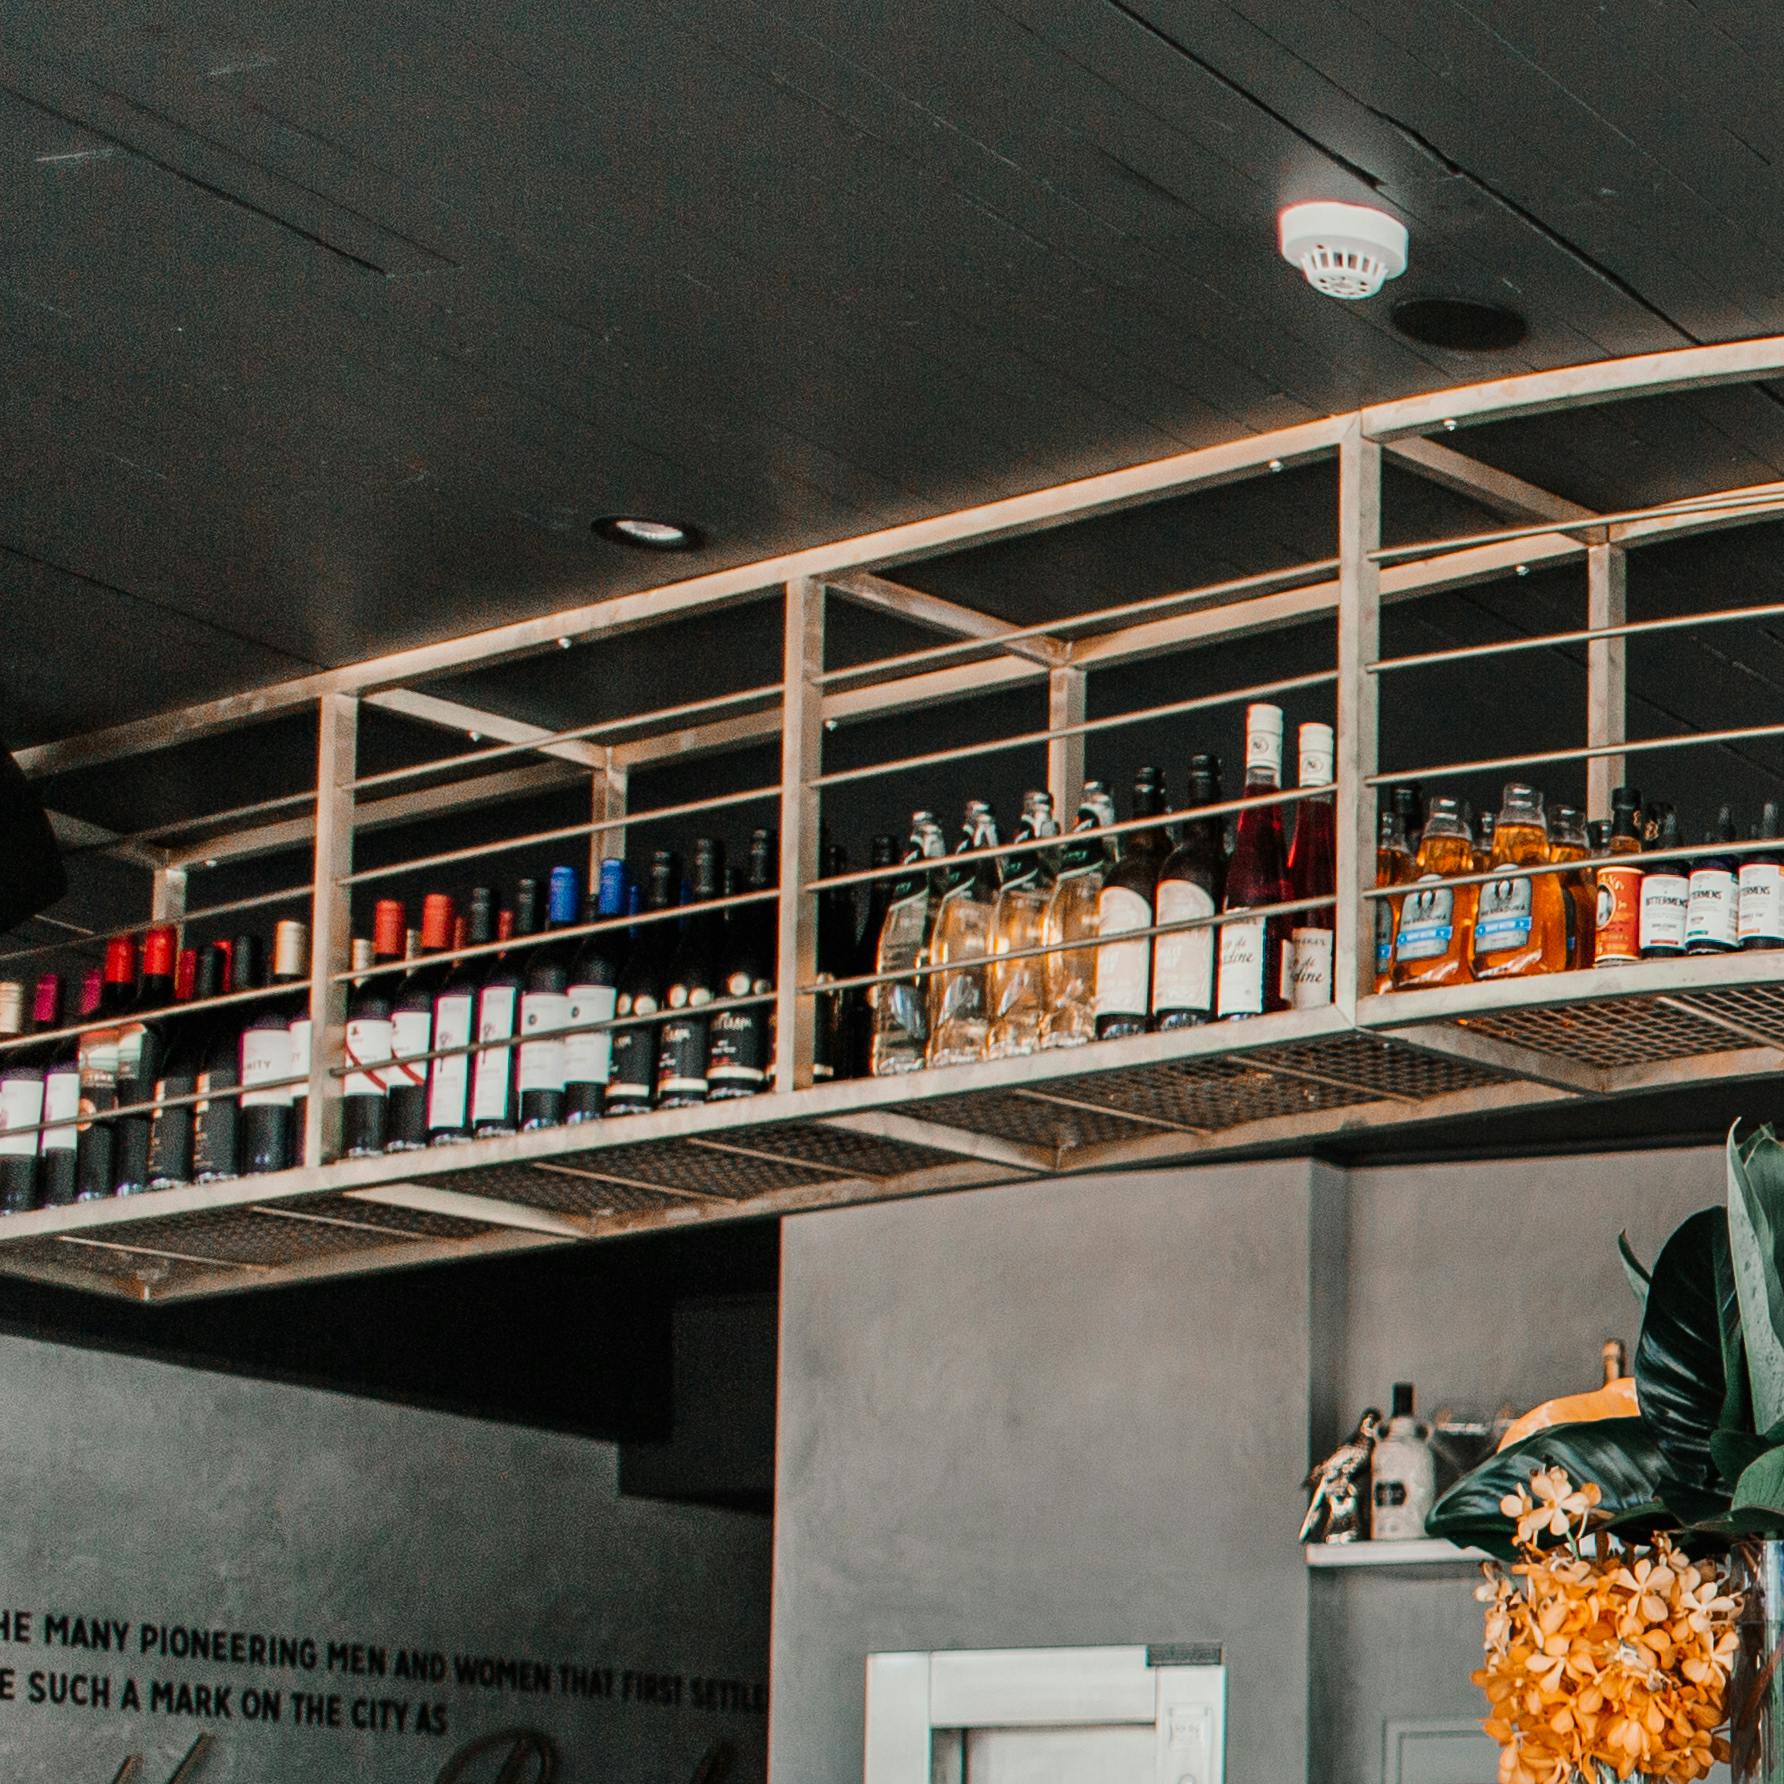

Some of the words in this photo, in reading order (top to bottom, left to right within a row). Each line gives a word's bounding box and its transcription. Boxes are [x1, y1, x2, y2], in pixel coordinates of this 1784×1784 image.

[0, 1608, 33, 1645] HE
[44, 1611, 130, 1653] MANY
[139, 1621, 318, 1671] PIONEERING
[324, 1640, 387, 1678] MEN
[394, 1650, 448, 1684] AND
[454, 1652, 552, 1695] WOMEN
[557, 1662, 614, 1700] THAT
[622, 1669, 682, 1707] FIRST
[28, 1670, 112, 1711] SUCH
[119, 1677, 141, 1712] A
[150, 1680, 233, 1721] MARK
[239, 1688, 283, 1724] ON
[289, 1691, 347, 1730] THE
[351, 1696, 408, 1734] CITY
[414, 1701, 449, 1738] AS
